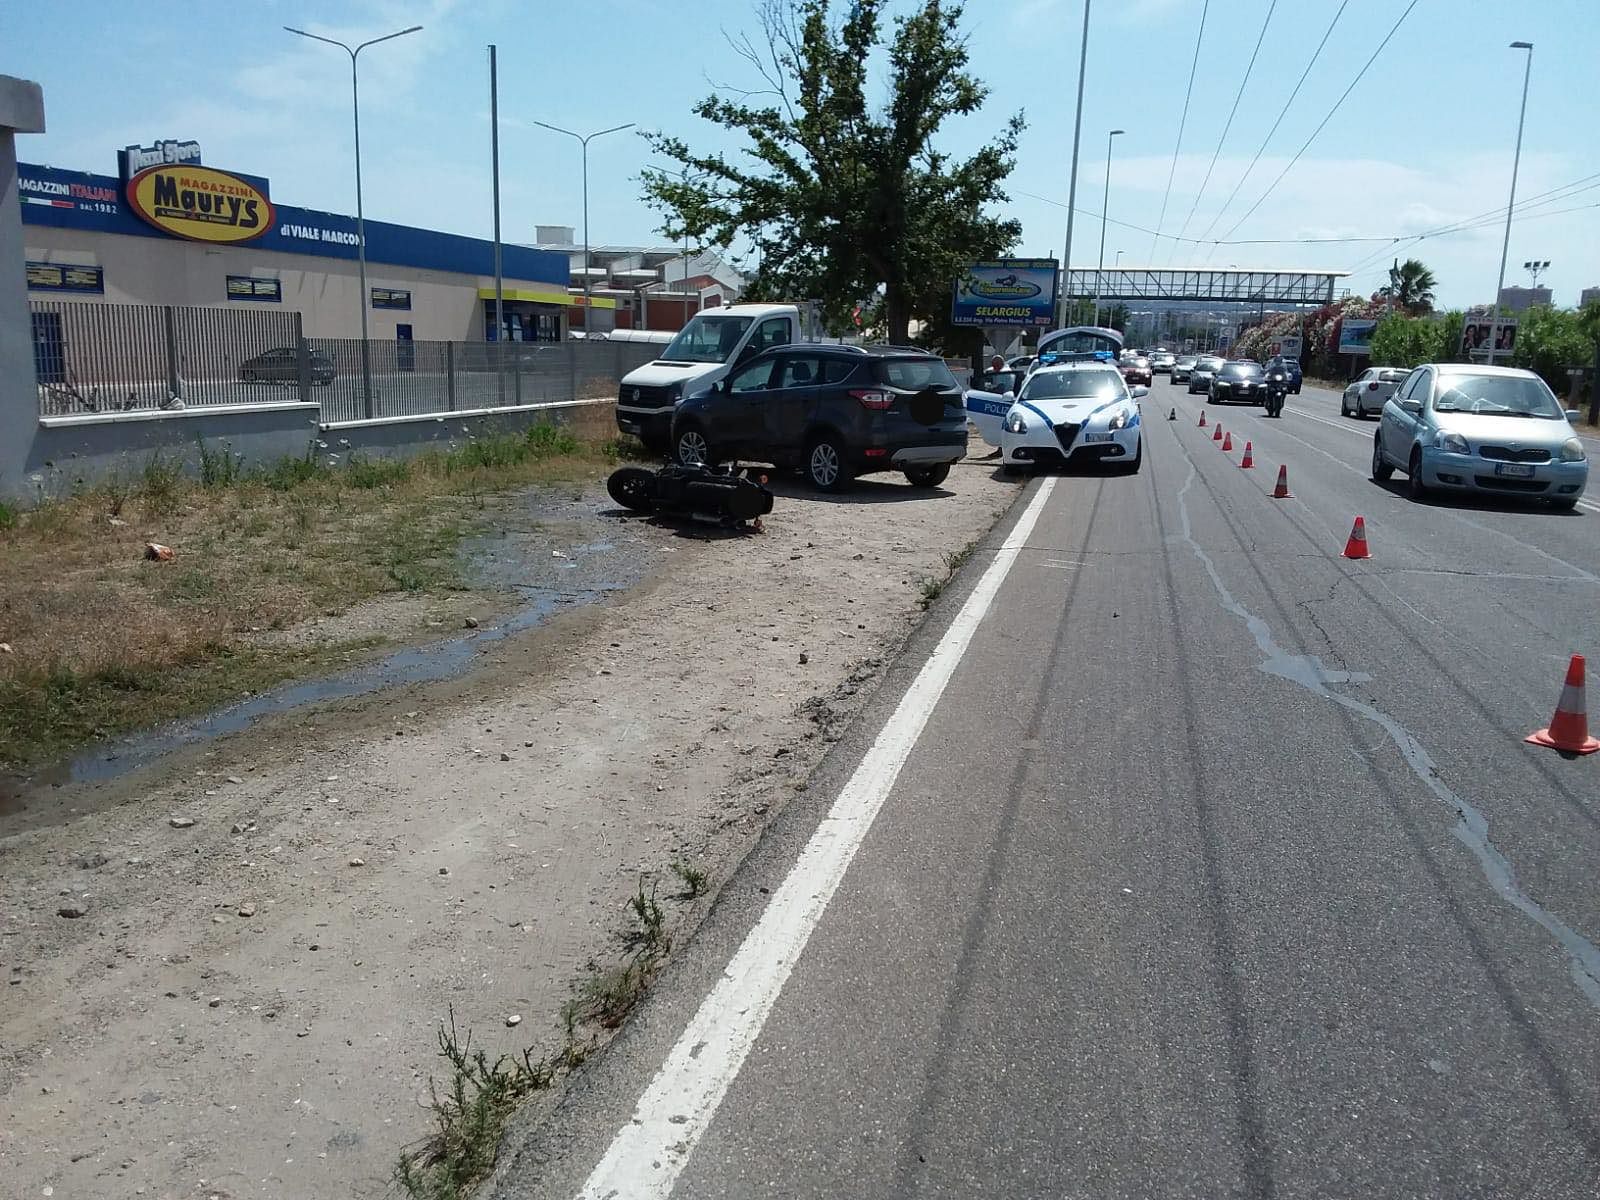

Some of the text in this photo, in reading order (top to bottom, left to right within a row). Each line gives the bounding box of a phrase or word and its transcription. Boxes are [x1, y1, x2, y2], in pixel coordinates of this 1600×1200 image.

[180, 176, 254, 198] MAGAZZINI
[94, 202, 118, 215] 1982
[154, 174, 259, 229] Maury's
[281, 223, 291, 237] di
[290, 224, 320, 241] VIALE
[975, 306, 1032, 317] SELARGIUS
